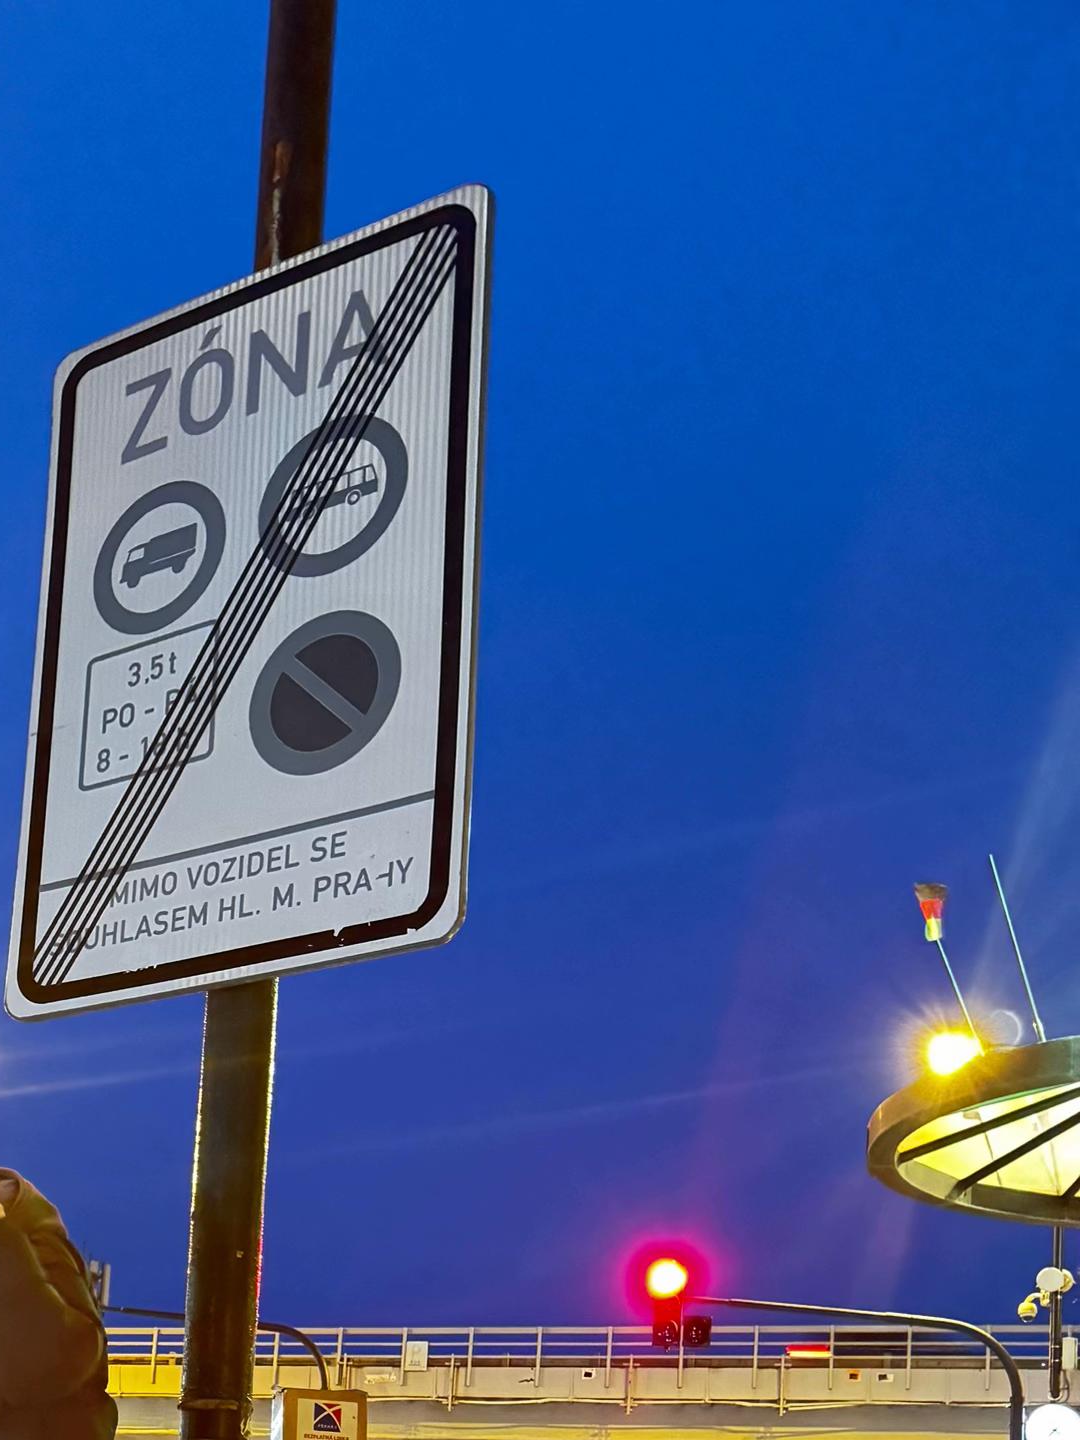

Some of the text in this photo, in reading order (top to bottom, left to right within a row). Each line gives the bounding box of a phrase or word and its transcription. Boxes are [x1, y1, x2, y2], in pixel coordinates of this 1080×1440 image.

[121, 289, 387, 465] ZÓNA
[102, 703, 135, 734] PO
[97, 748, 110, 773] 8
[110, 831, 348, 907] MIMO VOZIDEL SE
[218, 893, 260, 922] HL.
[272, 883, 301, 911] M.
